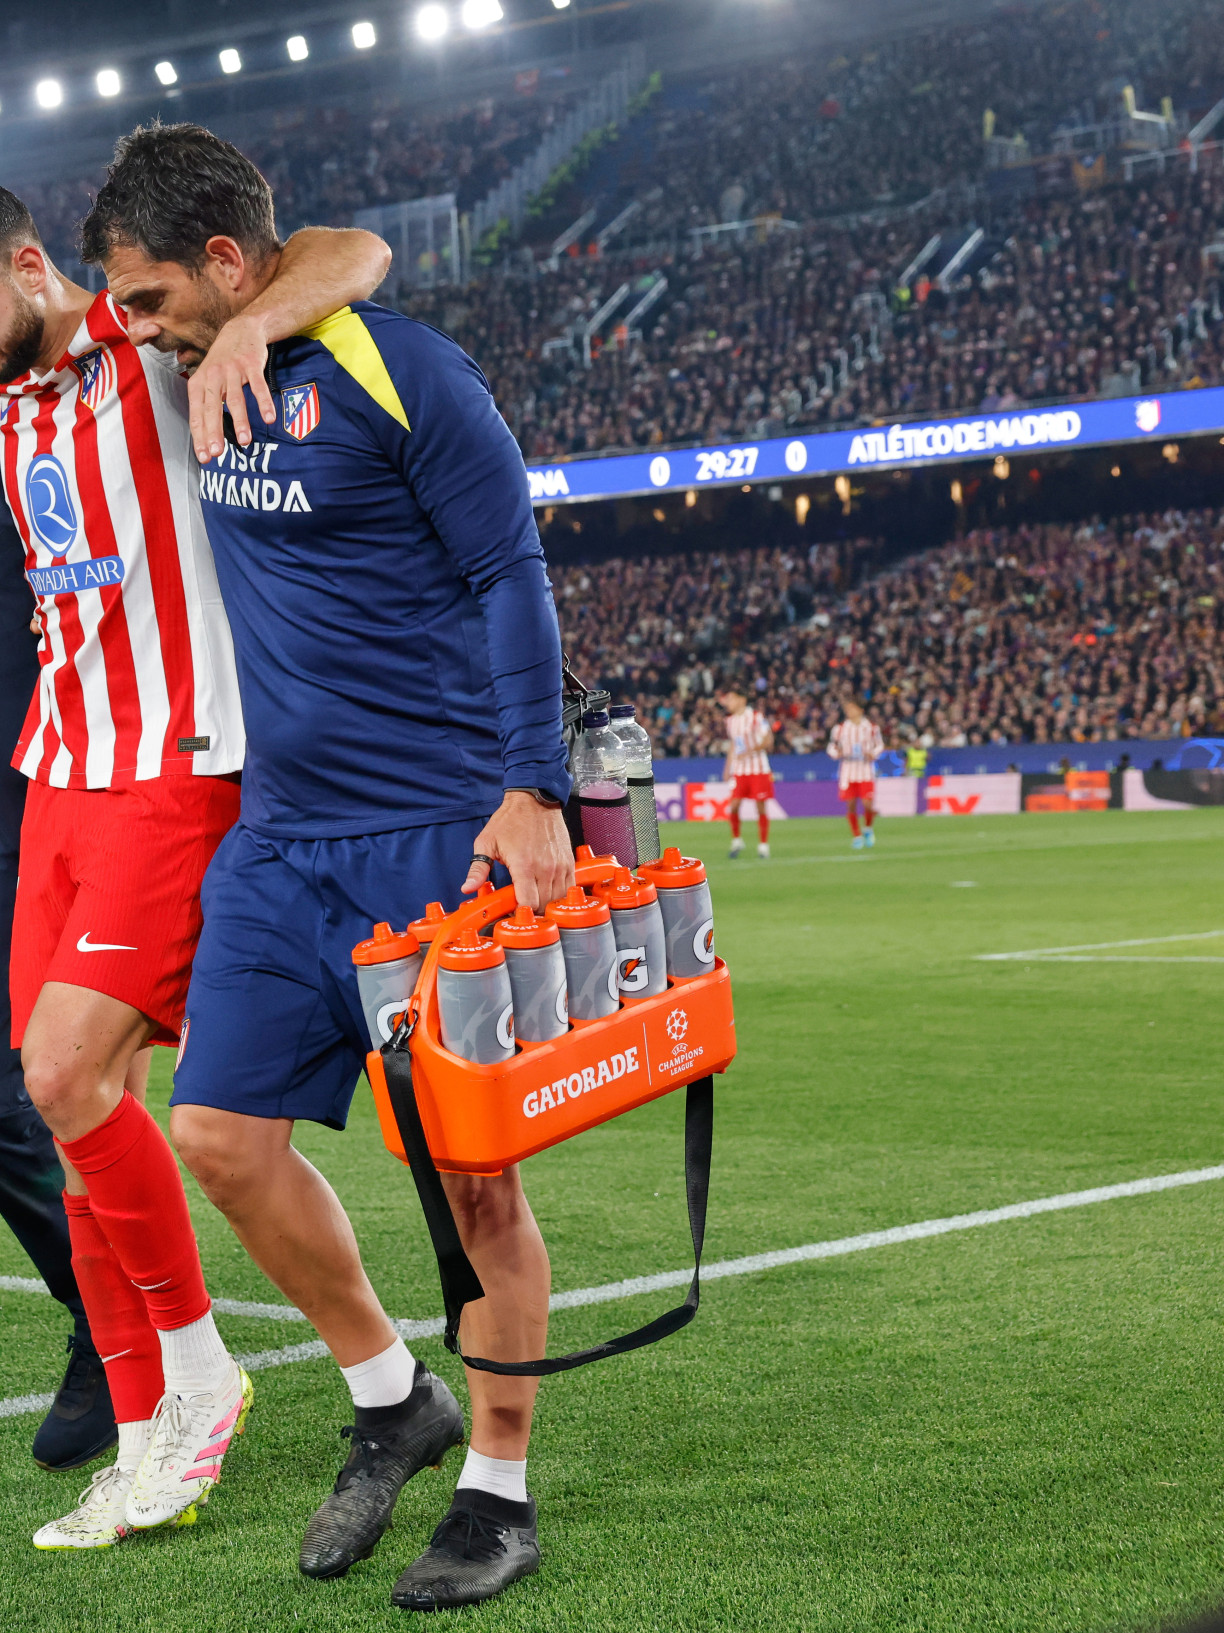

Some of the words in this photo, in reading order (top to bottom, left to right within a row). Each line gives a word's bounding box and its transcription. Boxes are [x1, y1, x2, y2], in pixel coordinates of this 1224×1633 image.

[649, 456, 671, 487] 0
[695, 447, 759, 481] 29:27
[785, 440, 808, 472] 0
[985, 411, 1081, 449] MADRID
[200, 469, 313, 512] RWANDA
[84, 559, 121, 585] AIR
[616, 946, 649, 993] G
[658, 1046, 704, 1072] CHAMPIONS
[671, 1060, 694, 1076] LEAGUE
[522, 1046, 639, 1118] GATORADE
